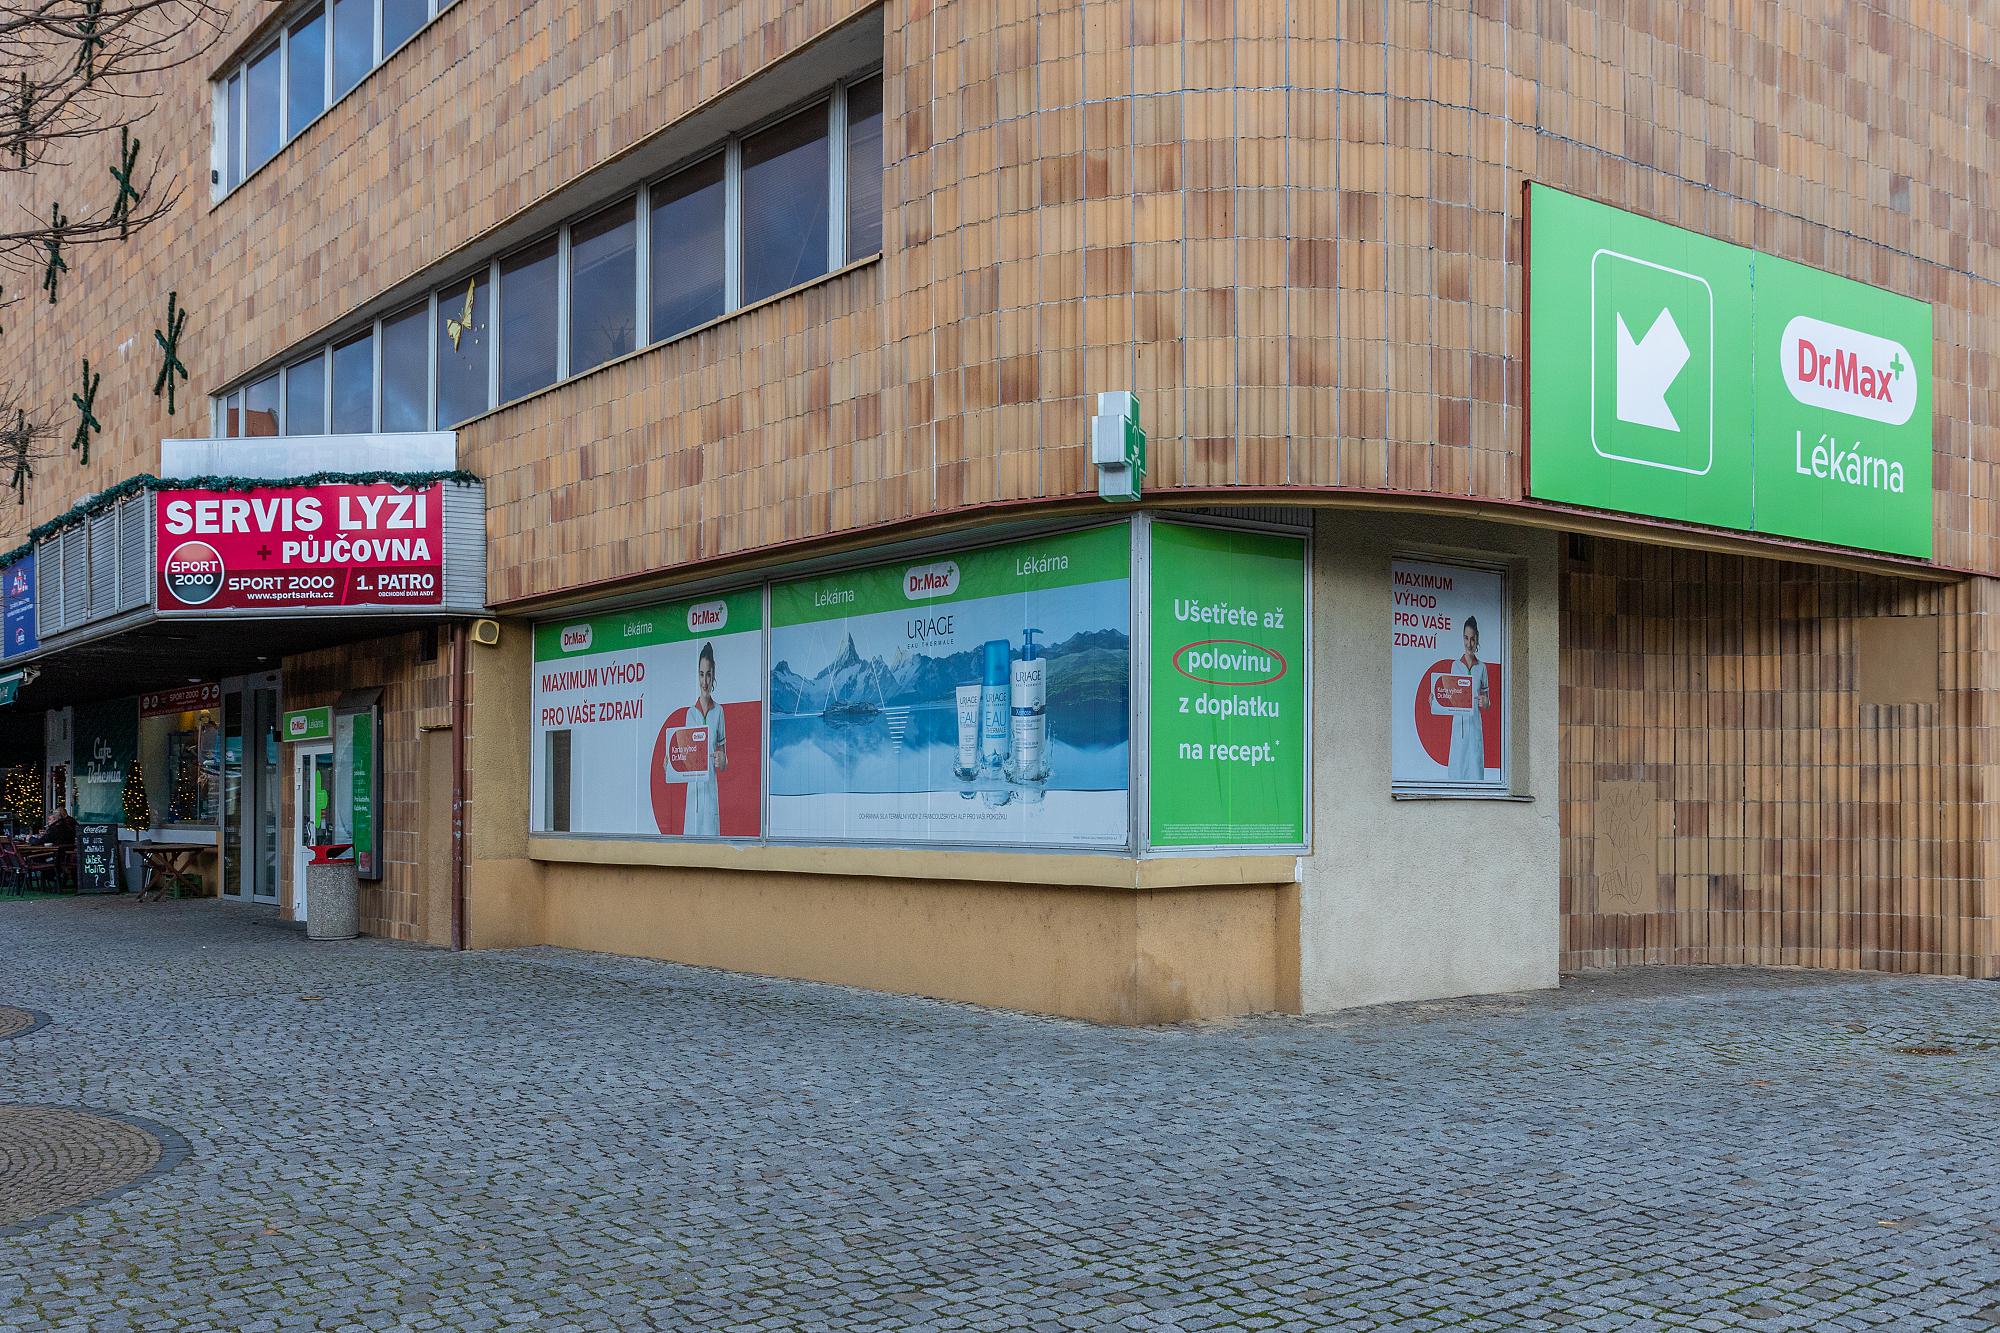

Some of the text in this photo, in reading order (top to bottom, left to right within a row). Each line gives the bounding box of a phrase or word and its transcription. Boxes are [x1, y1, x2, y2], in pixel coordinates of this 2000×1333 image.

[1796, 430, 1904, 493] Lékárna
[164, 485, 430, 535] SERVIS LYŽÍ
[282, 534, 431, 563] PŮJČOVNA
[171, 561, 218, 572] SPORT
[1016, 553, 1069, 576] Lékárna
[175, 574, 214, 585] 2000
[228, 576, 335, 591] SPORT 2000
[356, 573, 435, 590] 1. PATRO
[1394, 571, 1453, 591] MAXIMUM
[247, 591, 335, 600] www.sportsarka.cz
[815, 588, 855, 608] Lékárna
[1394, 589, 1437, 608] VÝHOD
[1174, 599, 1285, 629] Ušetřete až
[1394, 612, 1451, 631] PRO VAŠE
[623, 620, 653, 637] Lékárna
[907, 615, 954, 641] URIAGE
[922, 639, 954, 648] THERMALE
[1394, 633, 1438, 649] ZDRAVÍ
[1188, 648, 1271, 673] polovinu
[542, 660, 645, 693] MAXIMUM VÝHOD
[541, 693, 644, 727] PRO VAŠE ZDRAVÍ
[1179, 693, 1279, 720] z doplatku
[986, 711, 1007, 727] EAU
[1179, 742, 1203, 760] na
[87, 761, 122, 784] Bohemia
